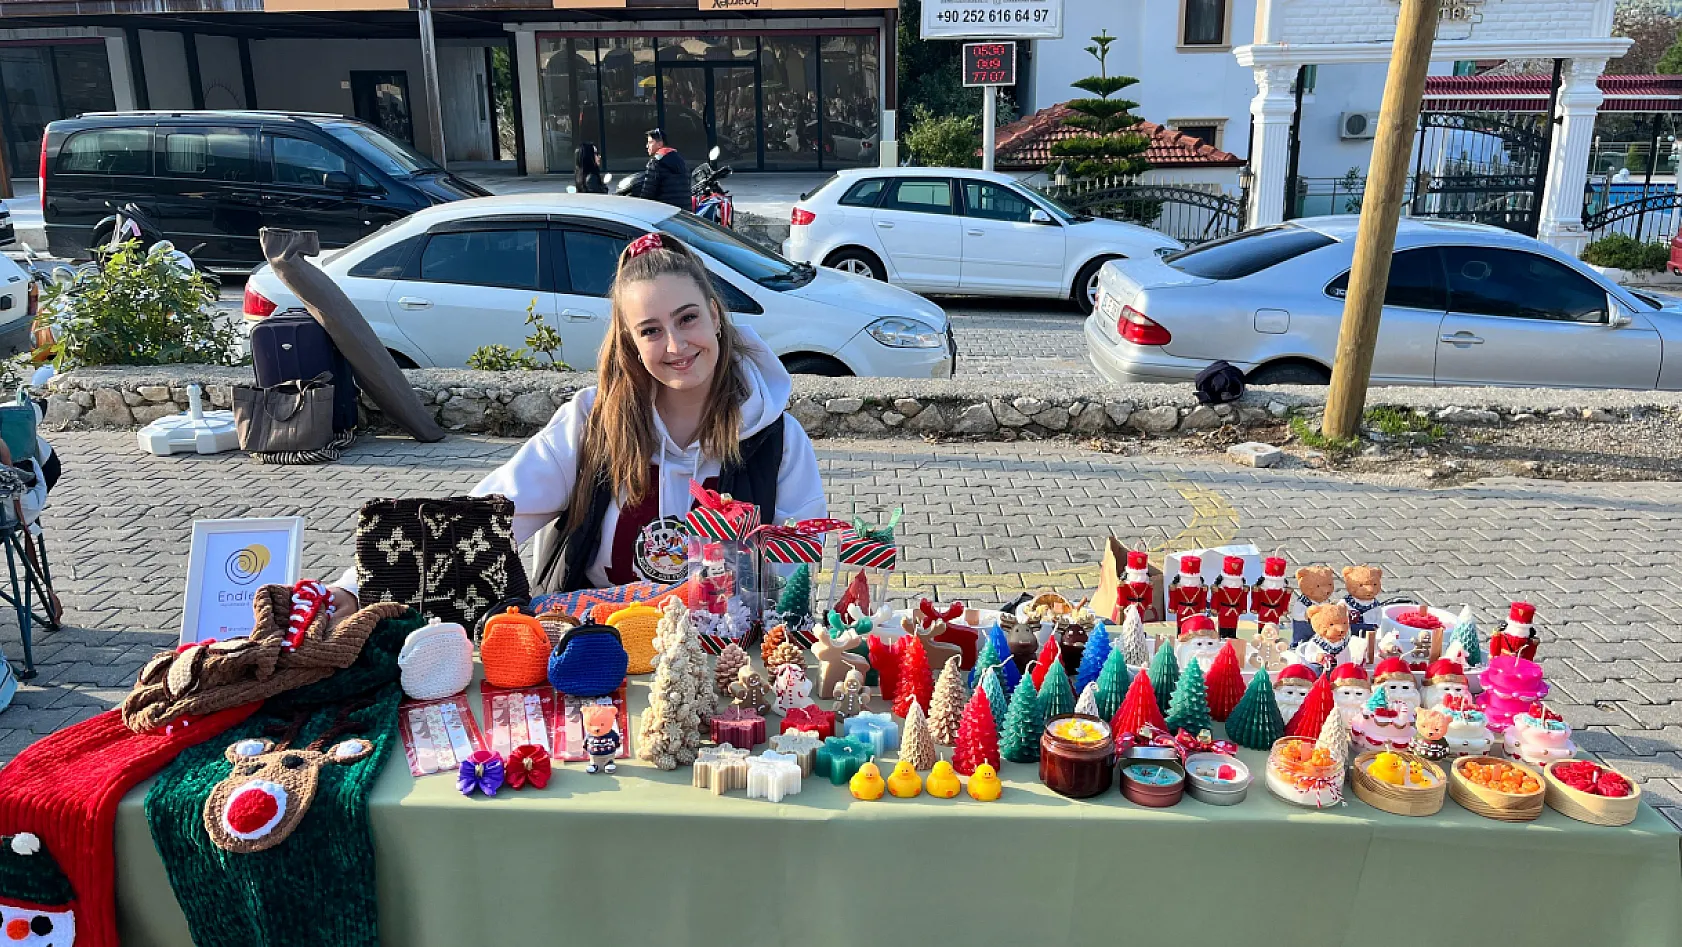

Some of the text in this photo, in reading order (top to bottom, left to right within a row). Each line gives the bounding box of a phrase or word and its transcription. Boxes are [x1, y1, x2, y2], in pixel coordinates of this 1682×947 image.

[937, 9, 1049, 22] +90 252 616 64 97
[218, 590, 255, 602] Endle
